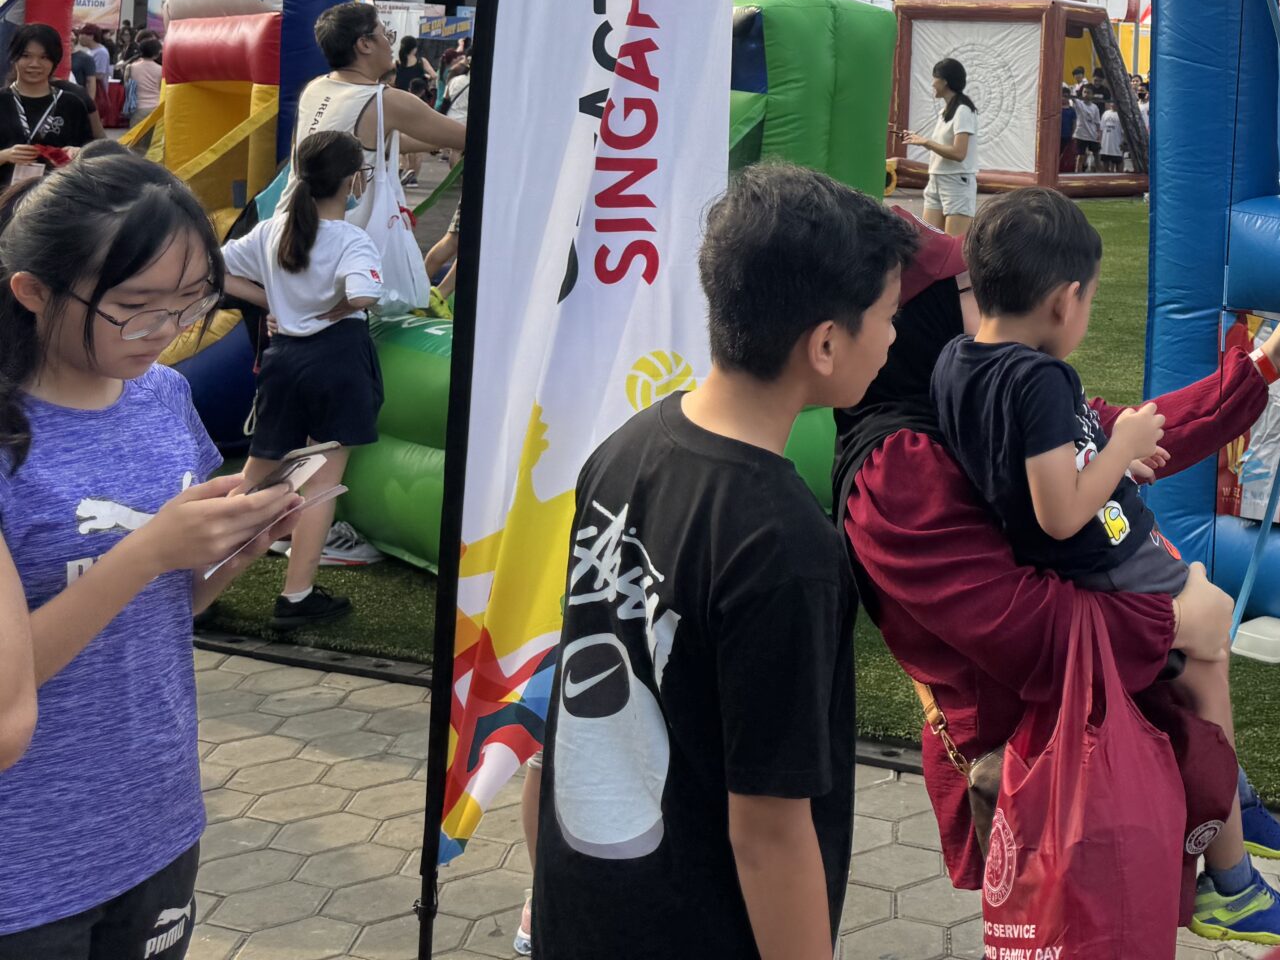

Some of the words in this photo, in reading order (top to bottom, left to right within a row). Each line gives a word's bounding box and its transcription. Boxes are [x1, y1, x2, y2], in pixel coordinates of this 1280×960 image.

[993, 923, 1036, 939] SERVICE
[999, 946, 1033, 960] FAMILY
[1035, 945, 1063, 960] DAY
